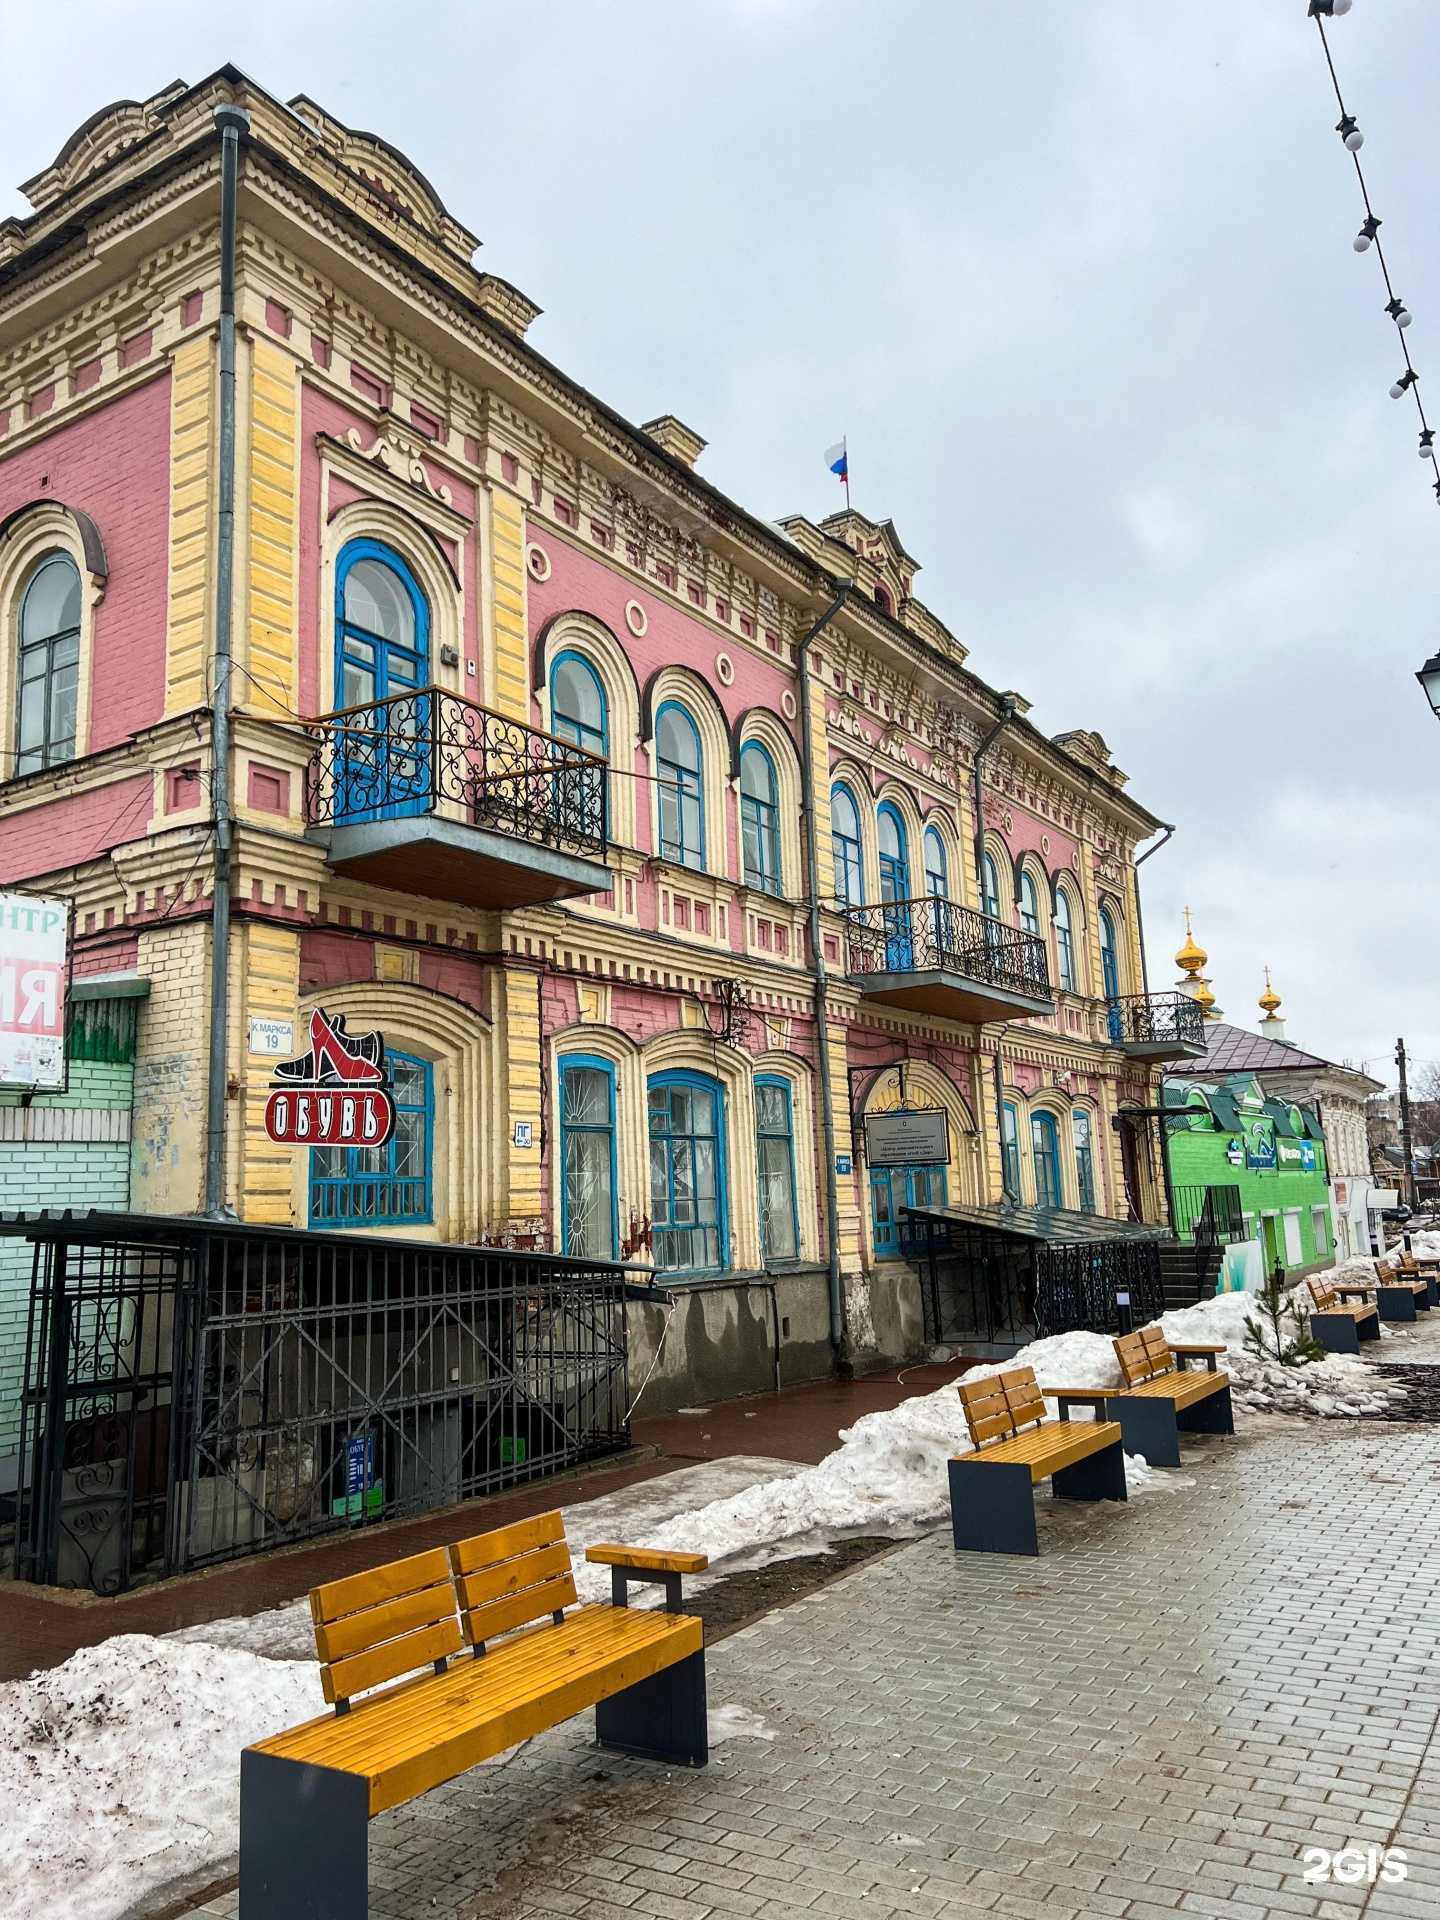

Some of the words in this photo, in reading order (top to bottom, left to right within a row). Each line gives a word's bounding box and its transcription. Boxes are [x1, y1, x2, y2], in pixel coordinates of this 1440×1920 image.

[265, 1034, 279, 1049] 19
[275, 1096, 377, 1138] ОБУВЬ
[517, 1125, 530, 1138] ПГ
